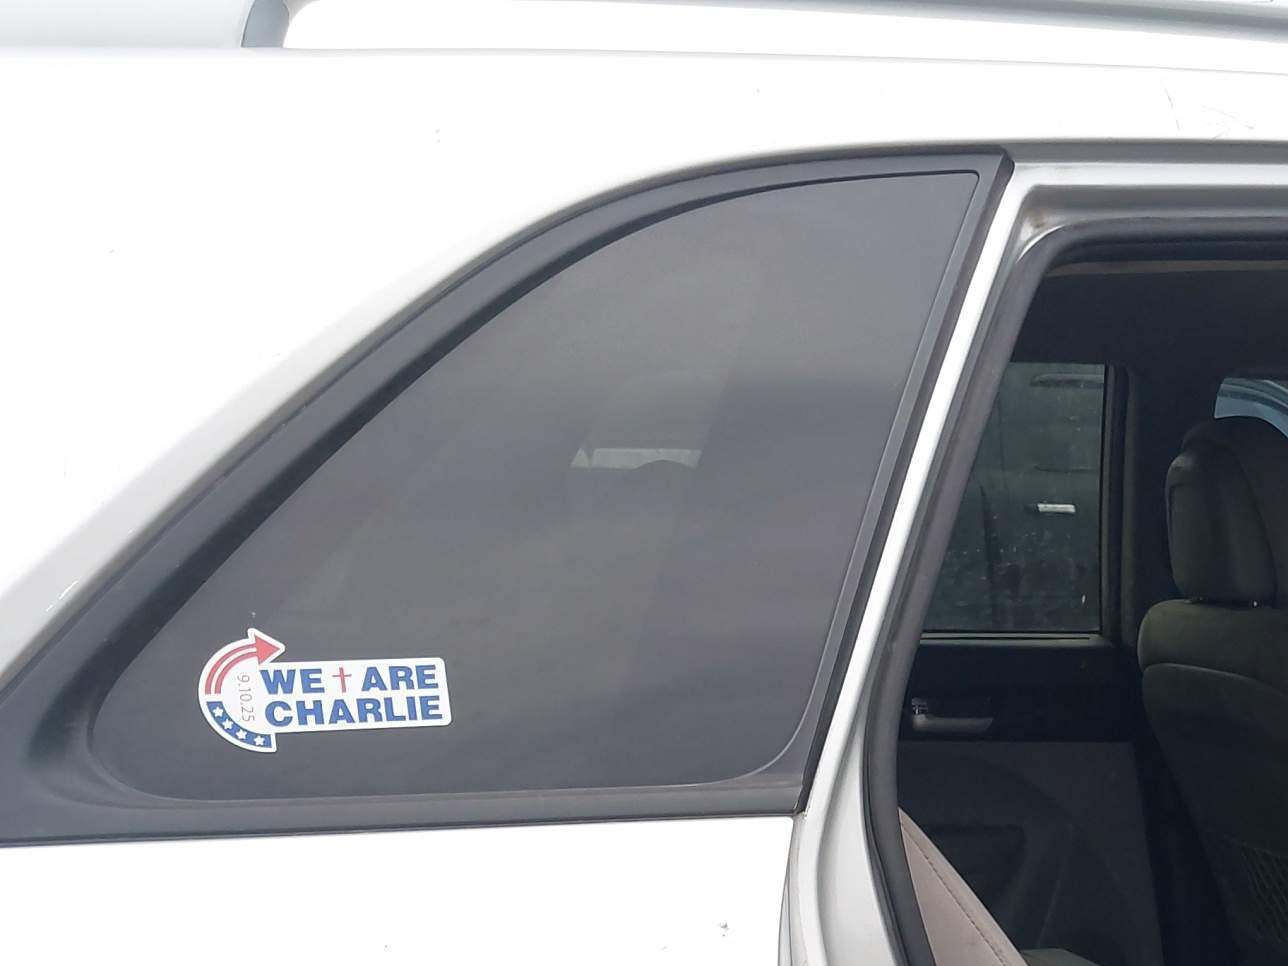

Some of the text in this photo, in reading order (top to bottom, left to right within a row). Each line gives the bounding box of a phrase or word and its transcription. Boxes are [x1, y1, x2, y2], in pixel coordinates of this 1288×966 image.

[260, 664, 438, 695] WE ARE
[236, 674, 256, 723] 9.10.25
[264, 695, 442, 727] CHARLIE
